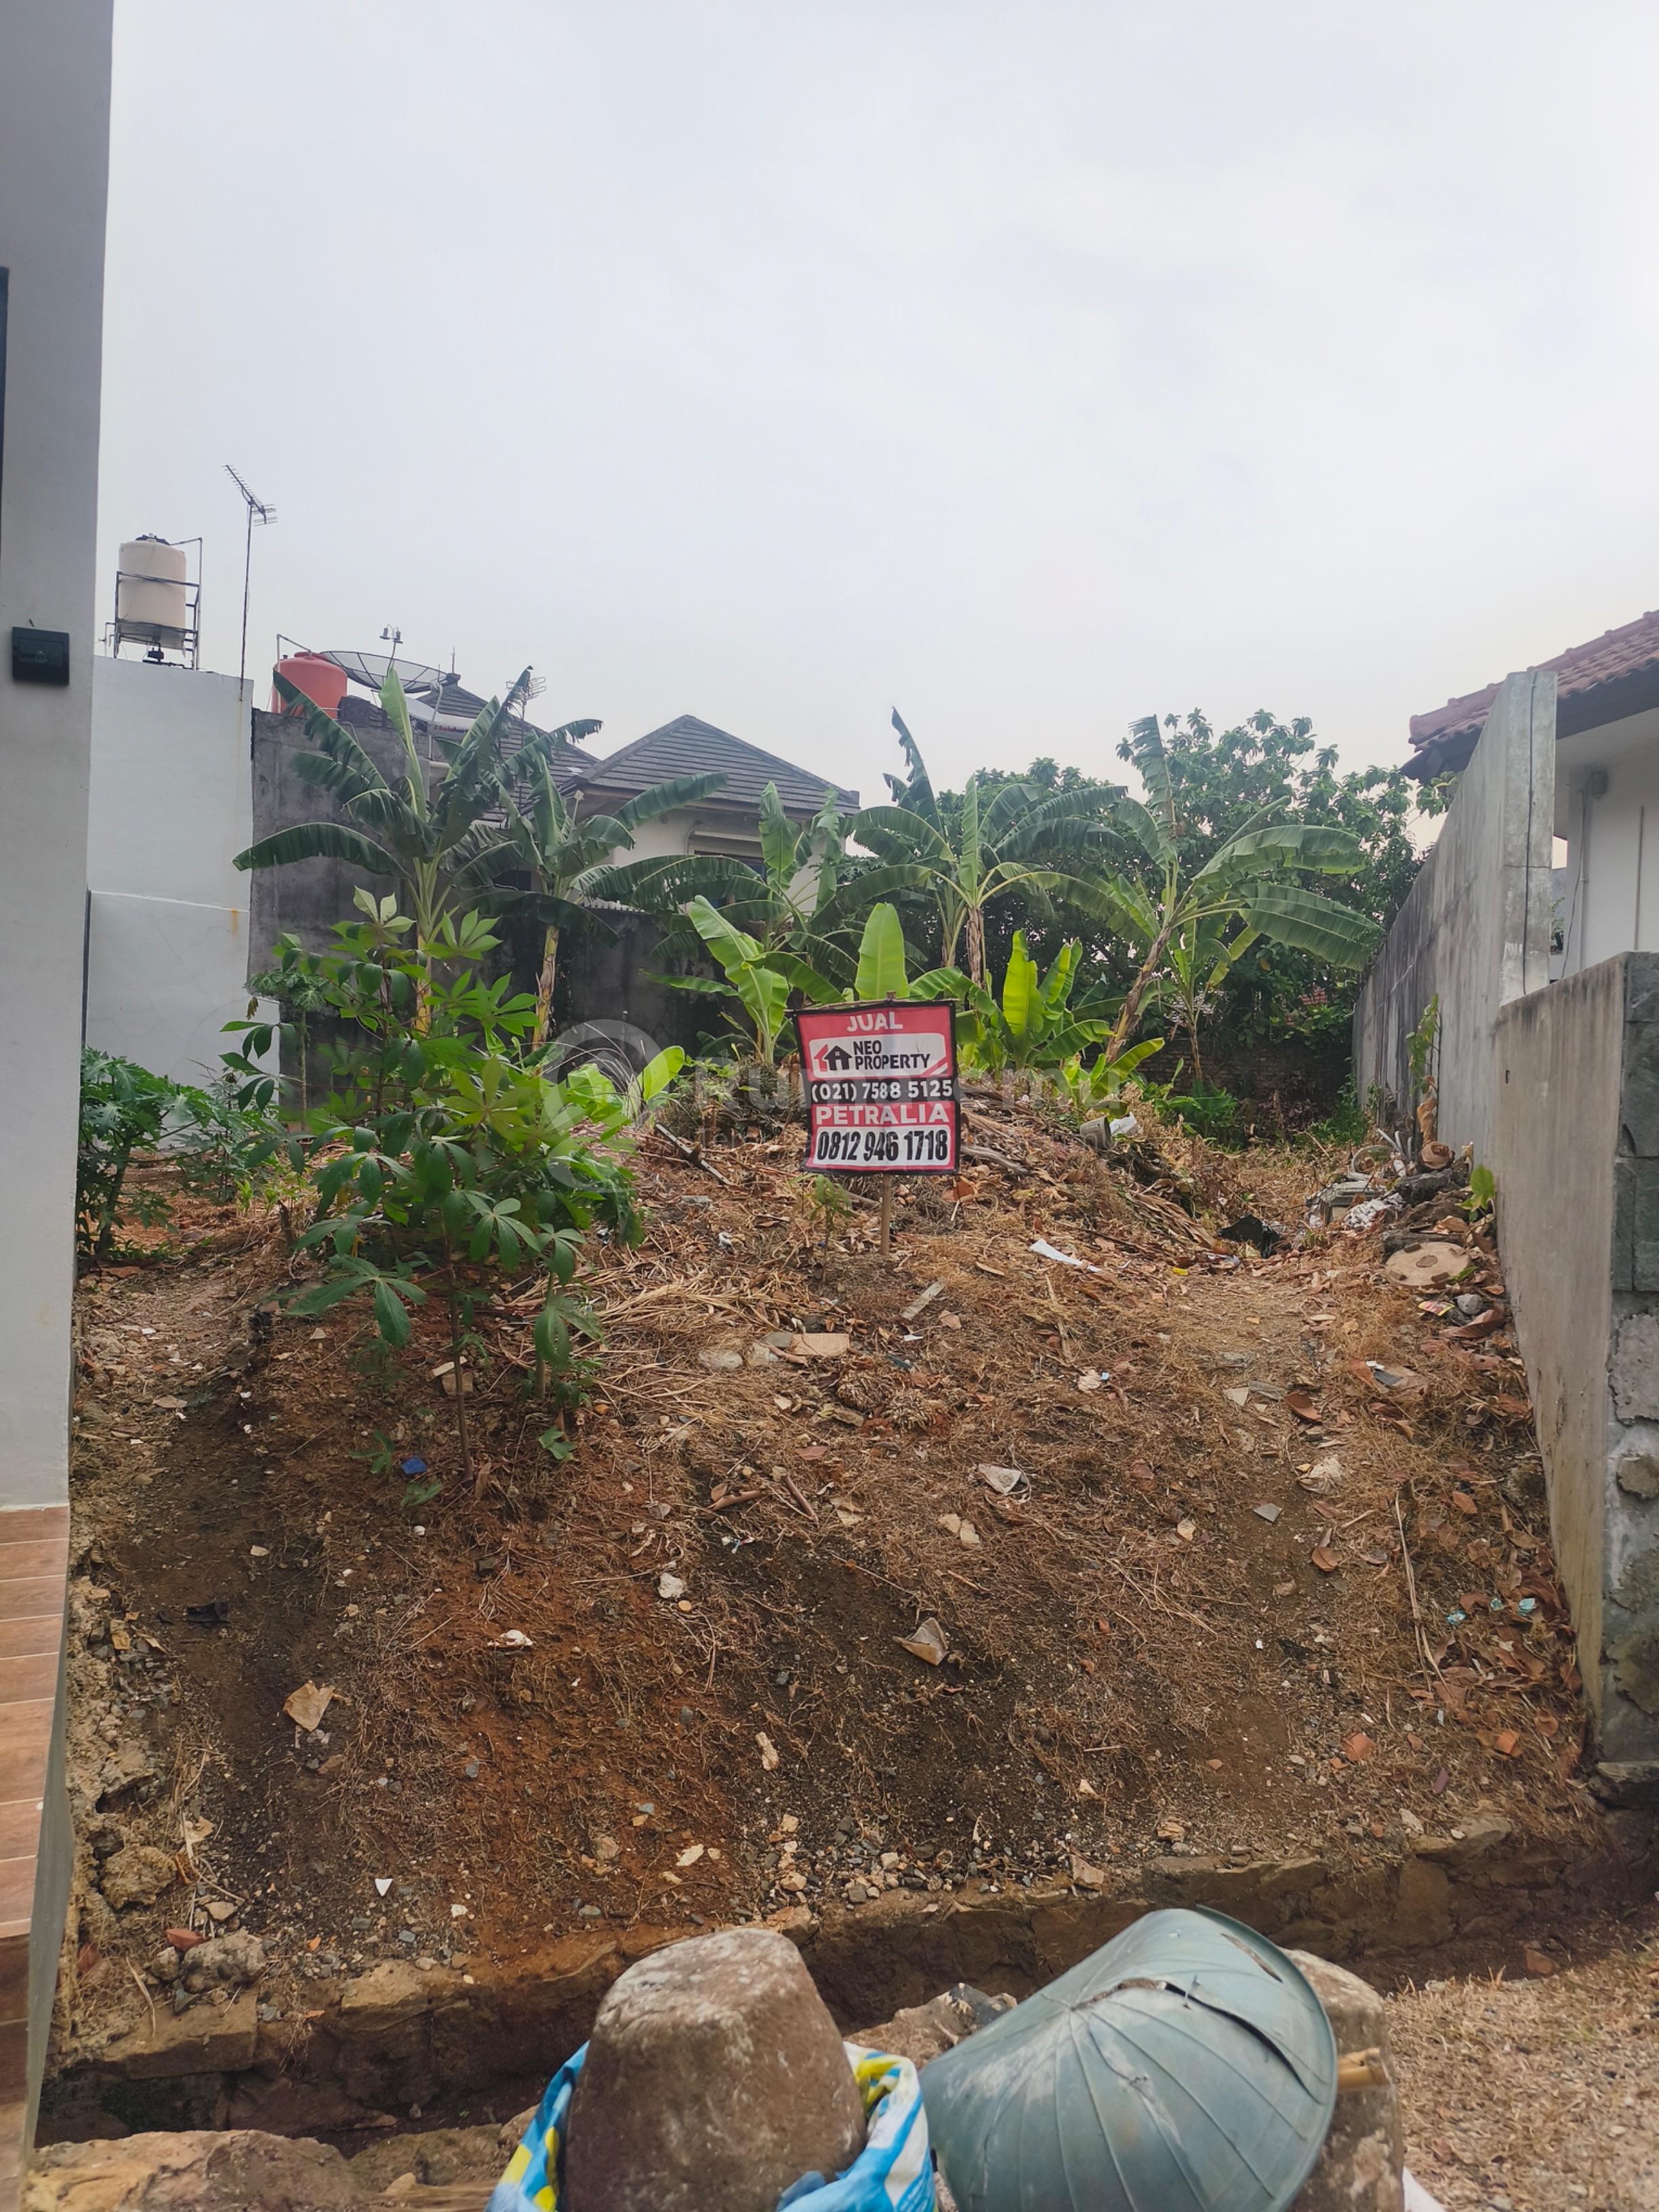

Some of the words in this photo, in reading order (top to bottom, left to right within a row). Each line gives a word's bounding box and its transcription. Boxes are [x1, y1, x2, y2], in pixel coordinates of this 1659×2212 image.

[846, 1011, 903, 1031] JUAL
[853, 1040, 882, 1055] NEO
[854, 1054, 930, 1070] PROPERTY
[811, 1083, 857, 1103] (021)
[862, 1082, 901, 1099] 7588
[907, 1080, 953, 1098] 5125
[815, 1103, 949, 1125] PETRALIA
[817, 1130, 861, 1161] 0812
[863, 1130, 899, 1162] 946
[903, 1129, 948, 1161] 1718
